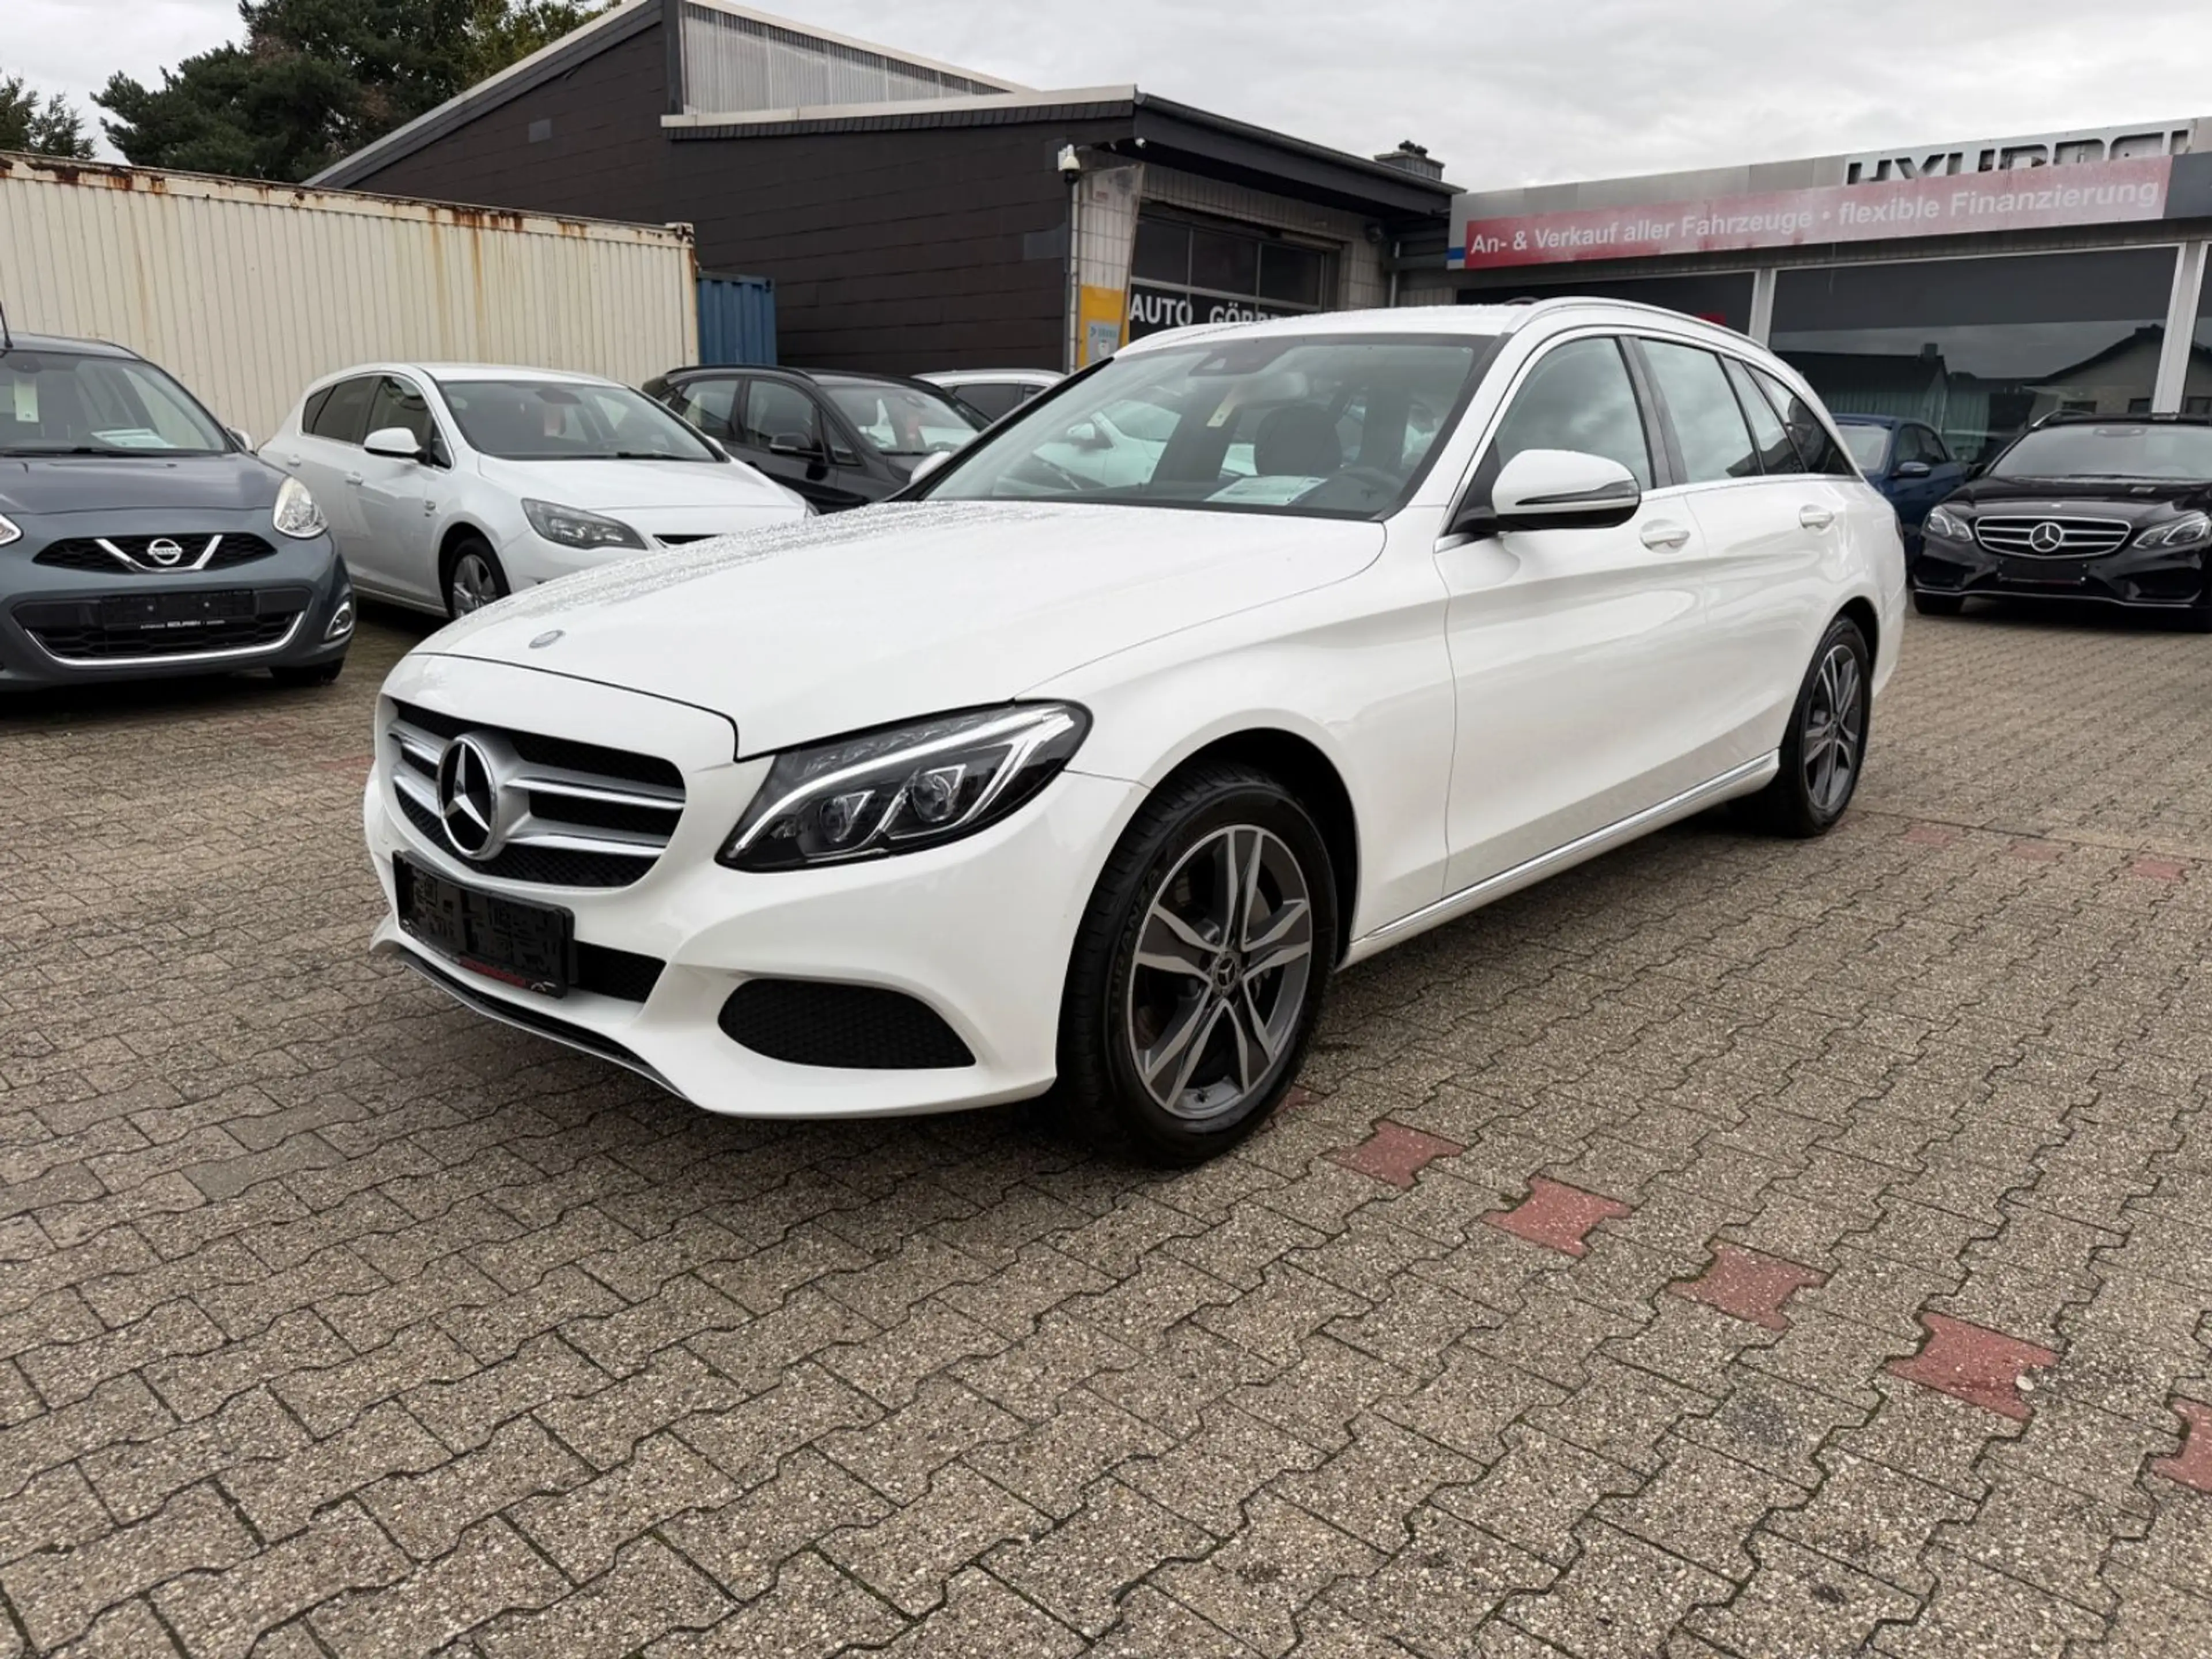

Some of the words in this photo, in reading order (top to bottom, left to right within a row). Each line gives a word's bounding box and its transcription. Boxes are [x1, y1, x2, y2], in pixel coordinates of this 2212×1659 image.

[1471, 234, 1507, 254] An-
[1513, 230, 1527, 251] &
[1535, 221, 1619, 248] Verkauf
[1624, 219, 1675, 242] aller
[1681, 210, 1813, 237] Fahrzeuge
[1839, 196, 1940, 226] flexible
[1950, 181, 2160, 217] Finanzierung
[1129, 293, 1194, 327] AUTO
